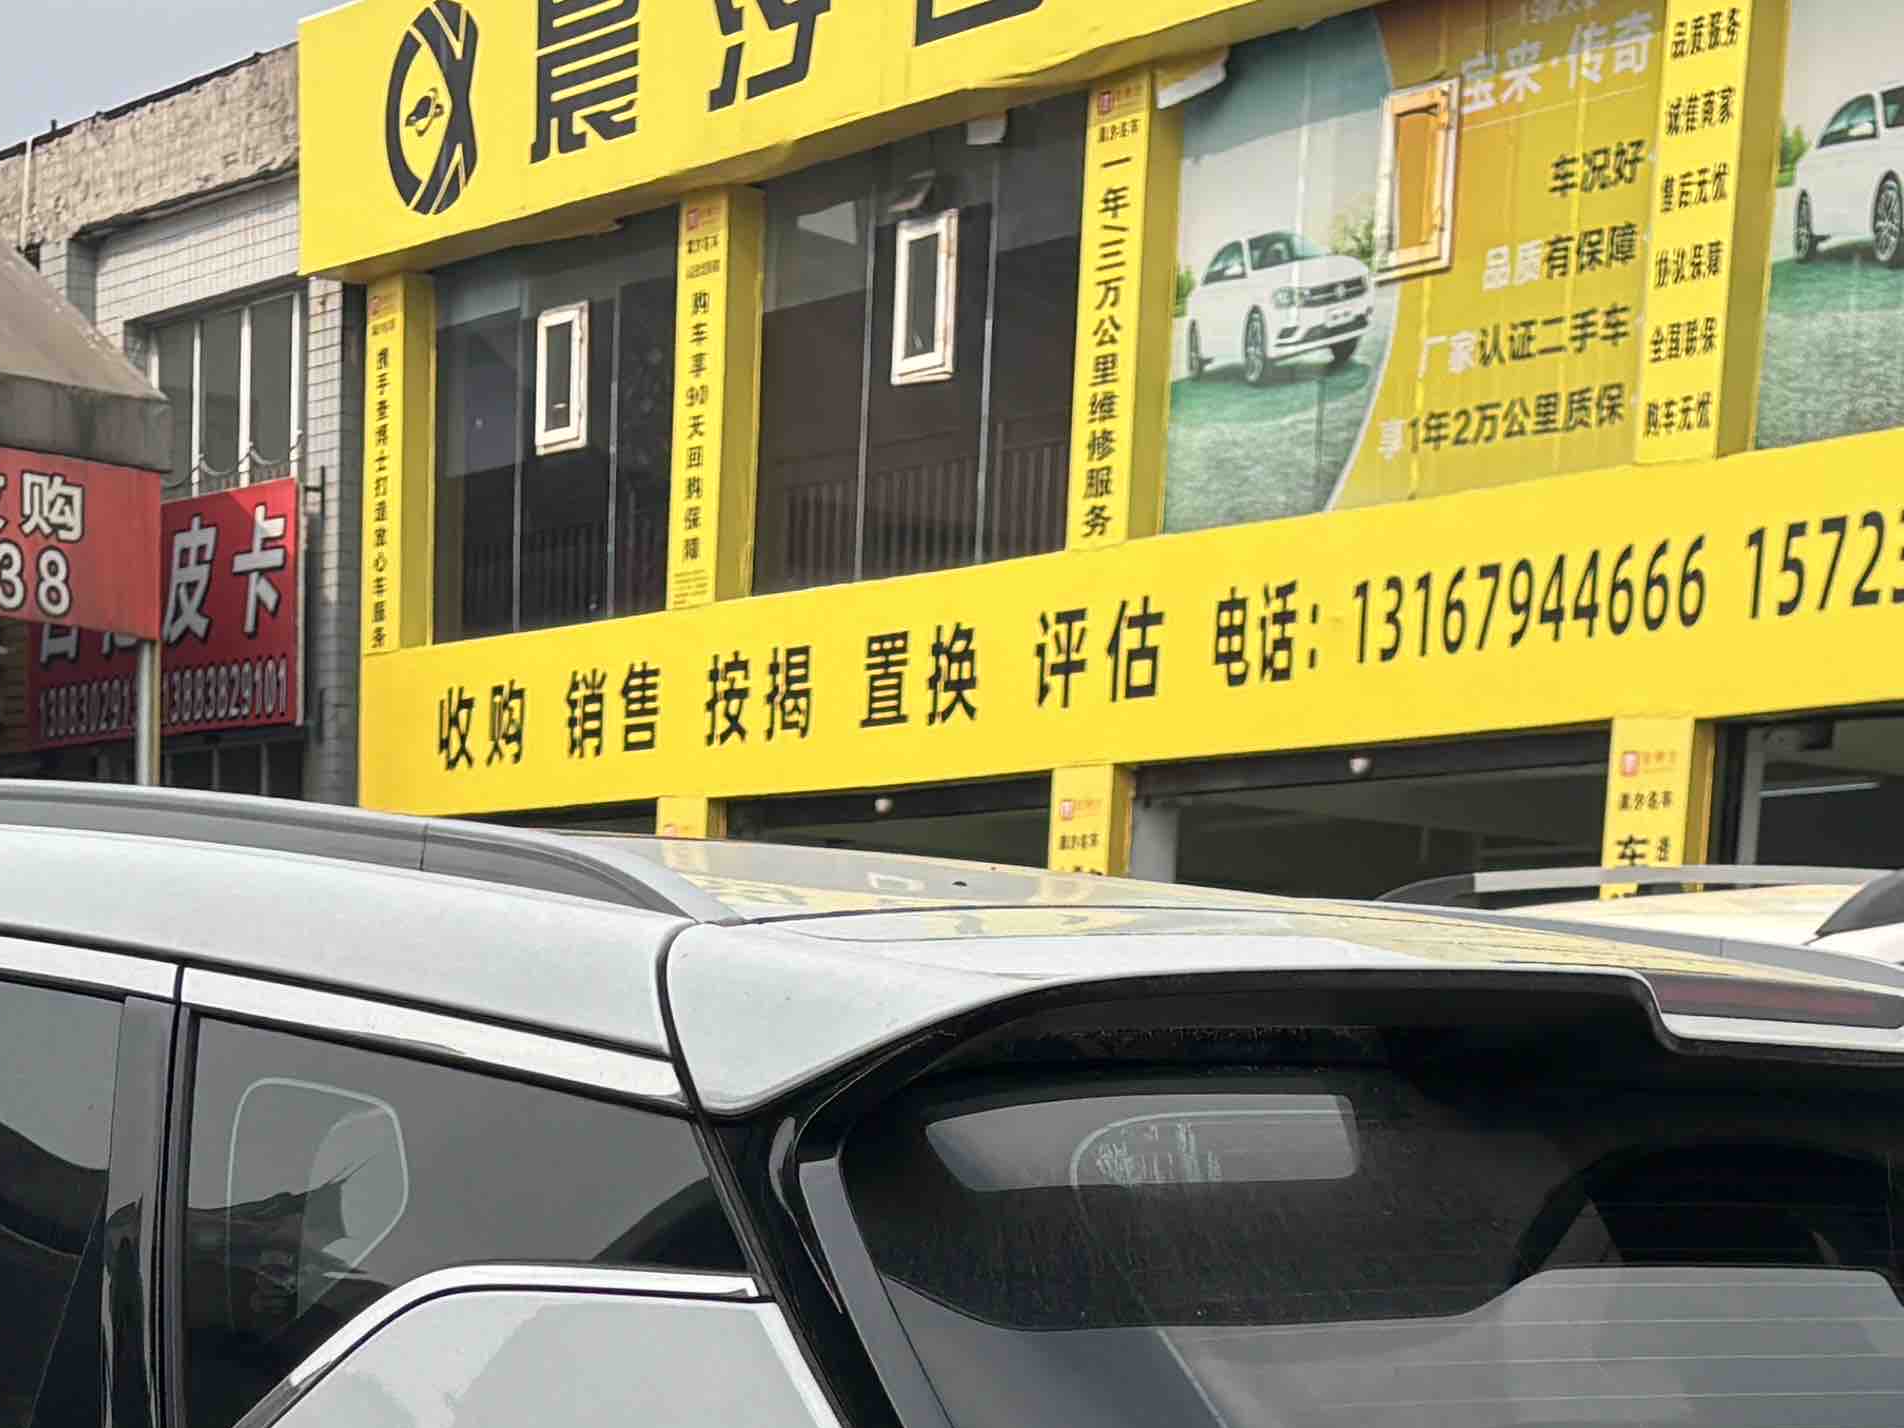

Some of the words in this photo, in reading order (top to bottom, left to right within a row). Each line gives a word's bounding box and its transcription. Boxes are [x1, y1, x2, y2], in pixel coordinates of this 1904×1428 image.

[1549, 139, 1647, 195] 车况好
[1481, 222, 1639, 292] 品质有保障
[1417, 303, 1632, 379] 厂家认证二手车
[436, 684, 527, 772] 收购
[565, 661, 663, 761] 销售
[704, 644, 813, 747] 按揭
[858, 623, 979, 729] 置换
[1034, 595, 1167, 711] 评估
[1352, 532, 1707, 664] 13167944666
